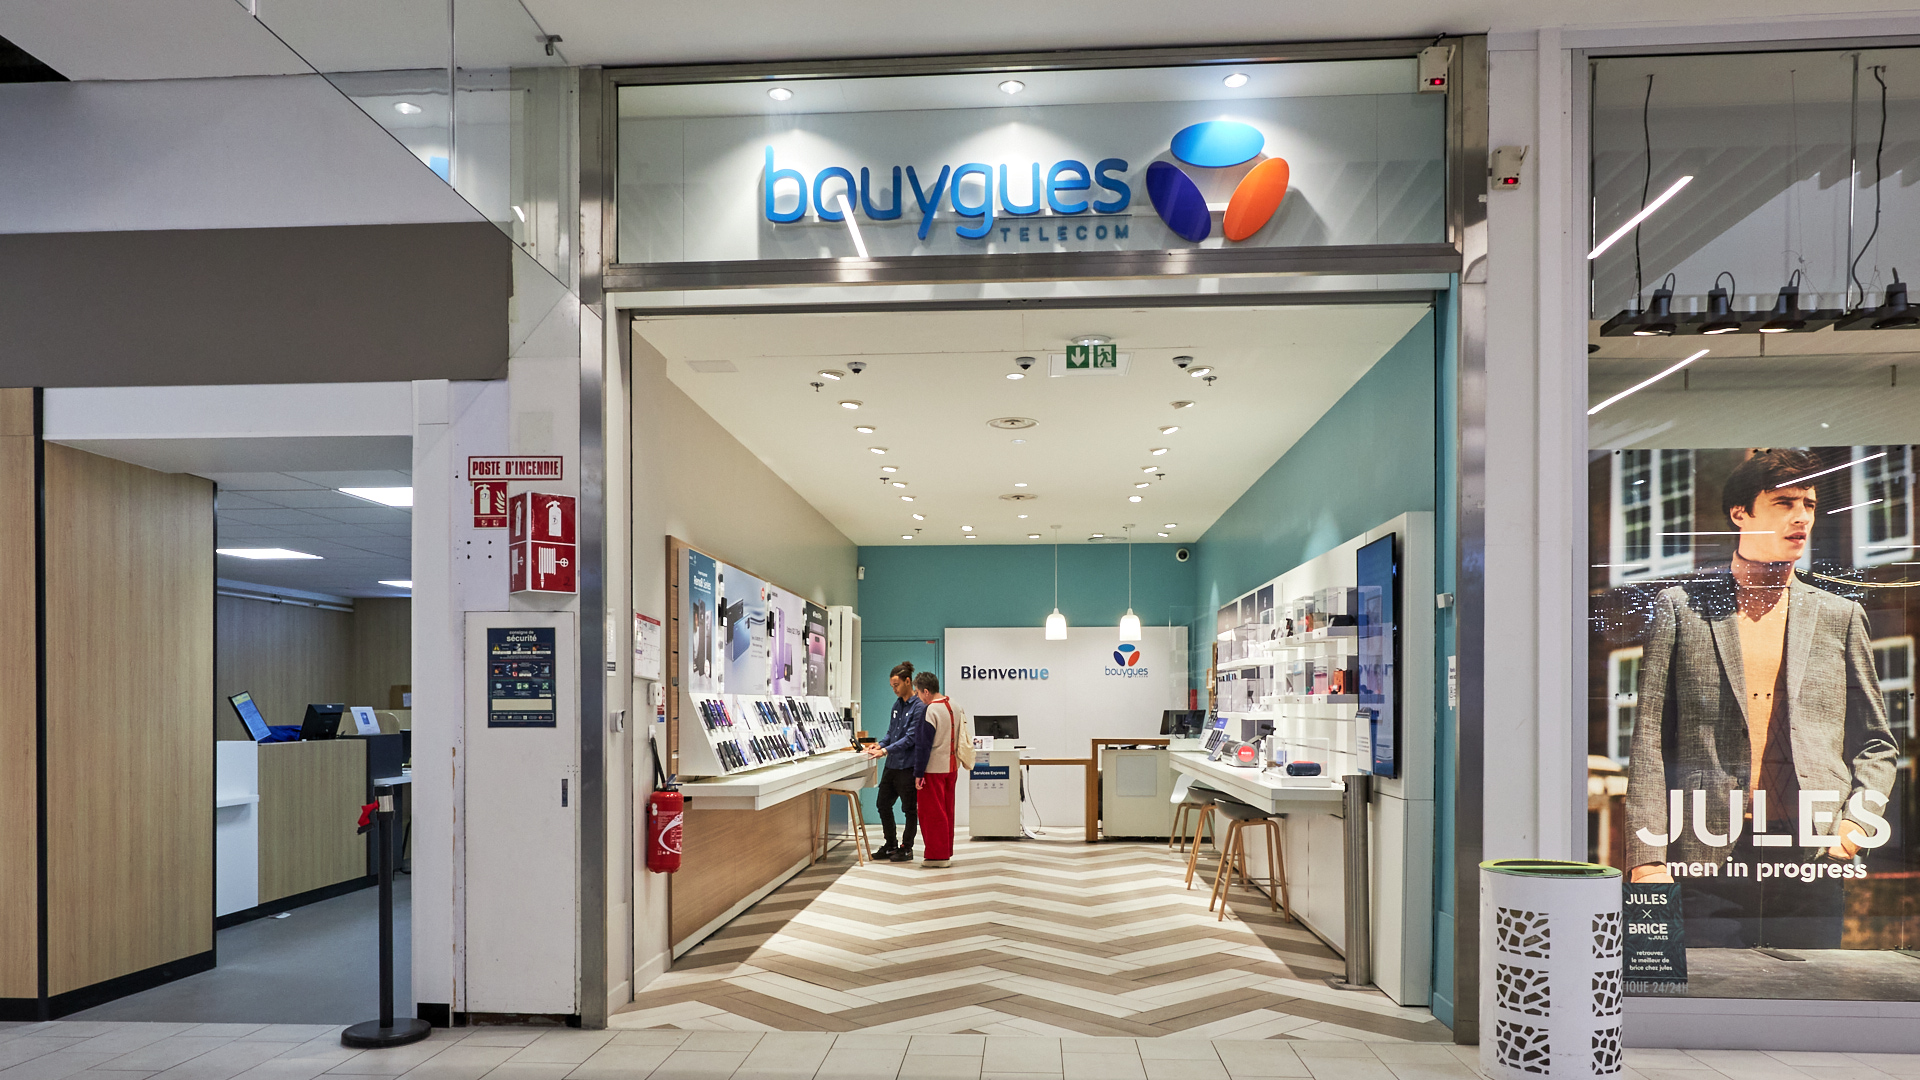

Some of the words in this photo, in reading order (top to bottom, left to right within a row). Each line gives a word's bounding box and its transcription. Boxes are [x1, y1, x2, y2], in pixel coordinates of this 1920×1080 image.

[765, 145, 1131, 240] bouygues
[1001, 224, 1129, 242] TELECOM
[472, 461, 501, 476] POSTE
[505, 461, 559, 476] D'INCENDIE
[506, 634, 537, 642] sécurité
[961, 665, 1049, 680] Bienvenue
[1105, 666, 1149, 678] bouygues
[1636, 789, 1892, 848] JULES
[1667, 860, 1718, 877] men
[1726, 857, 1748, 877] in
[1757, 860, 1868, 882] progress
[1625, 893, 1668, 905] JULES
[1628, 923, 1668, 934] BRICE
[1652, 981, 1689, 994] 24/24H
